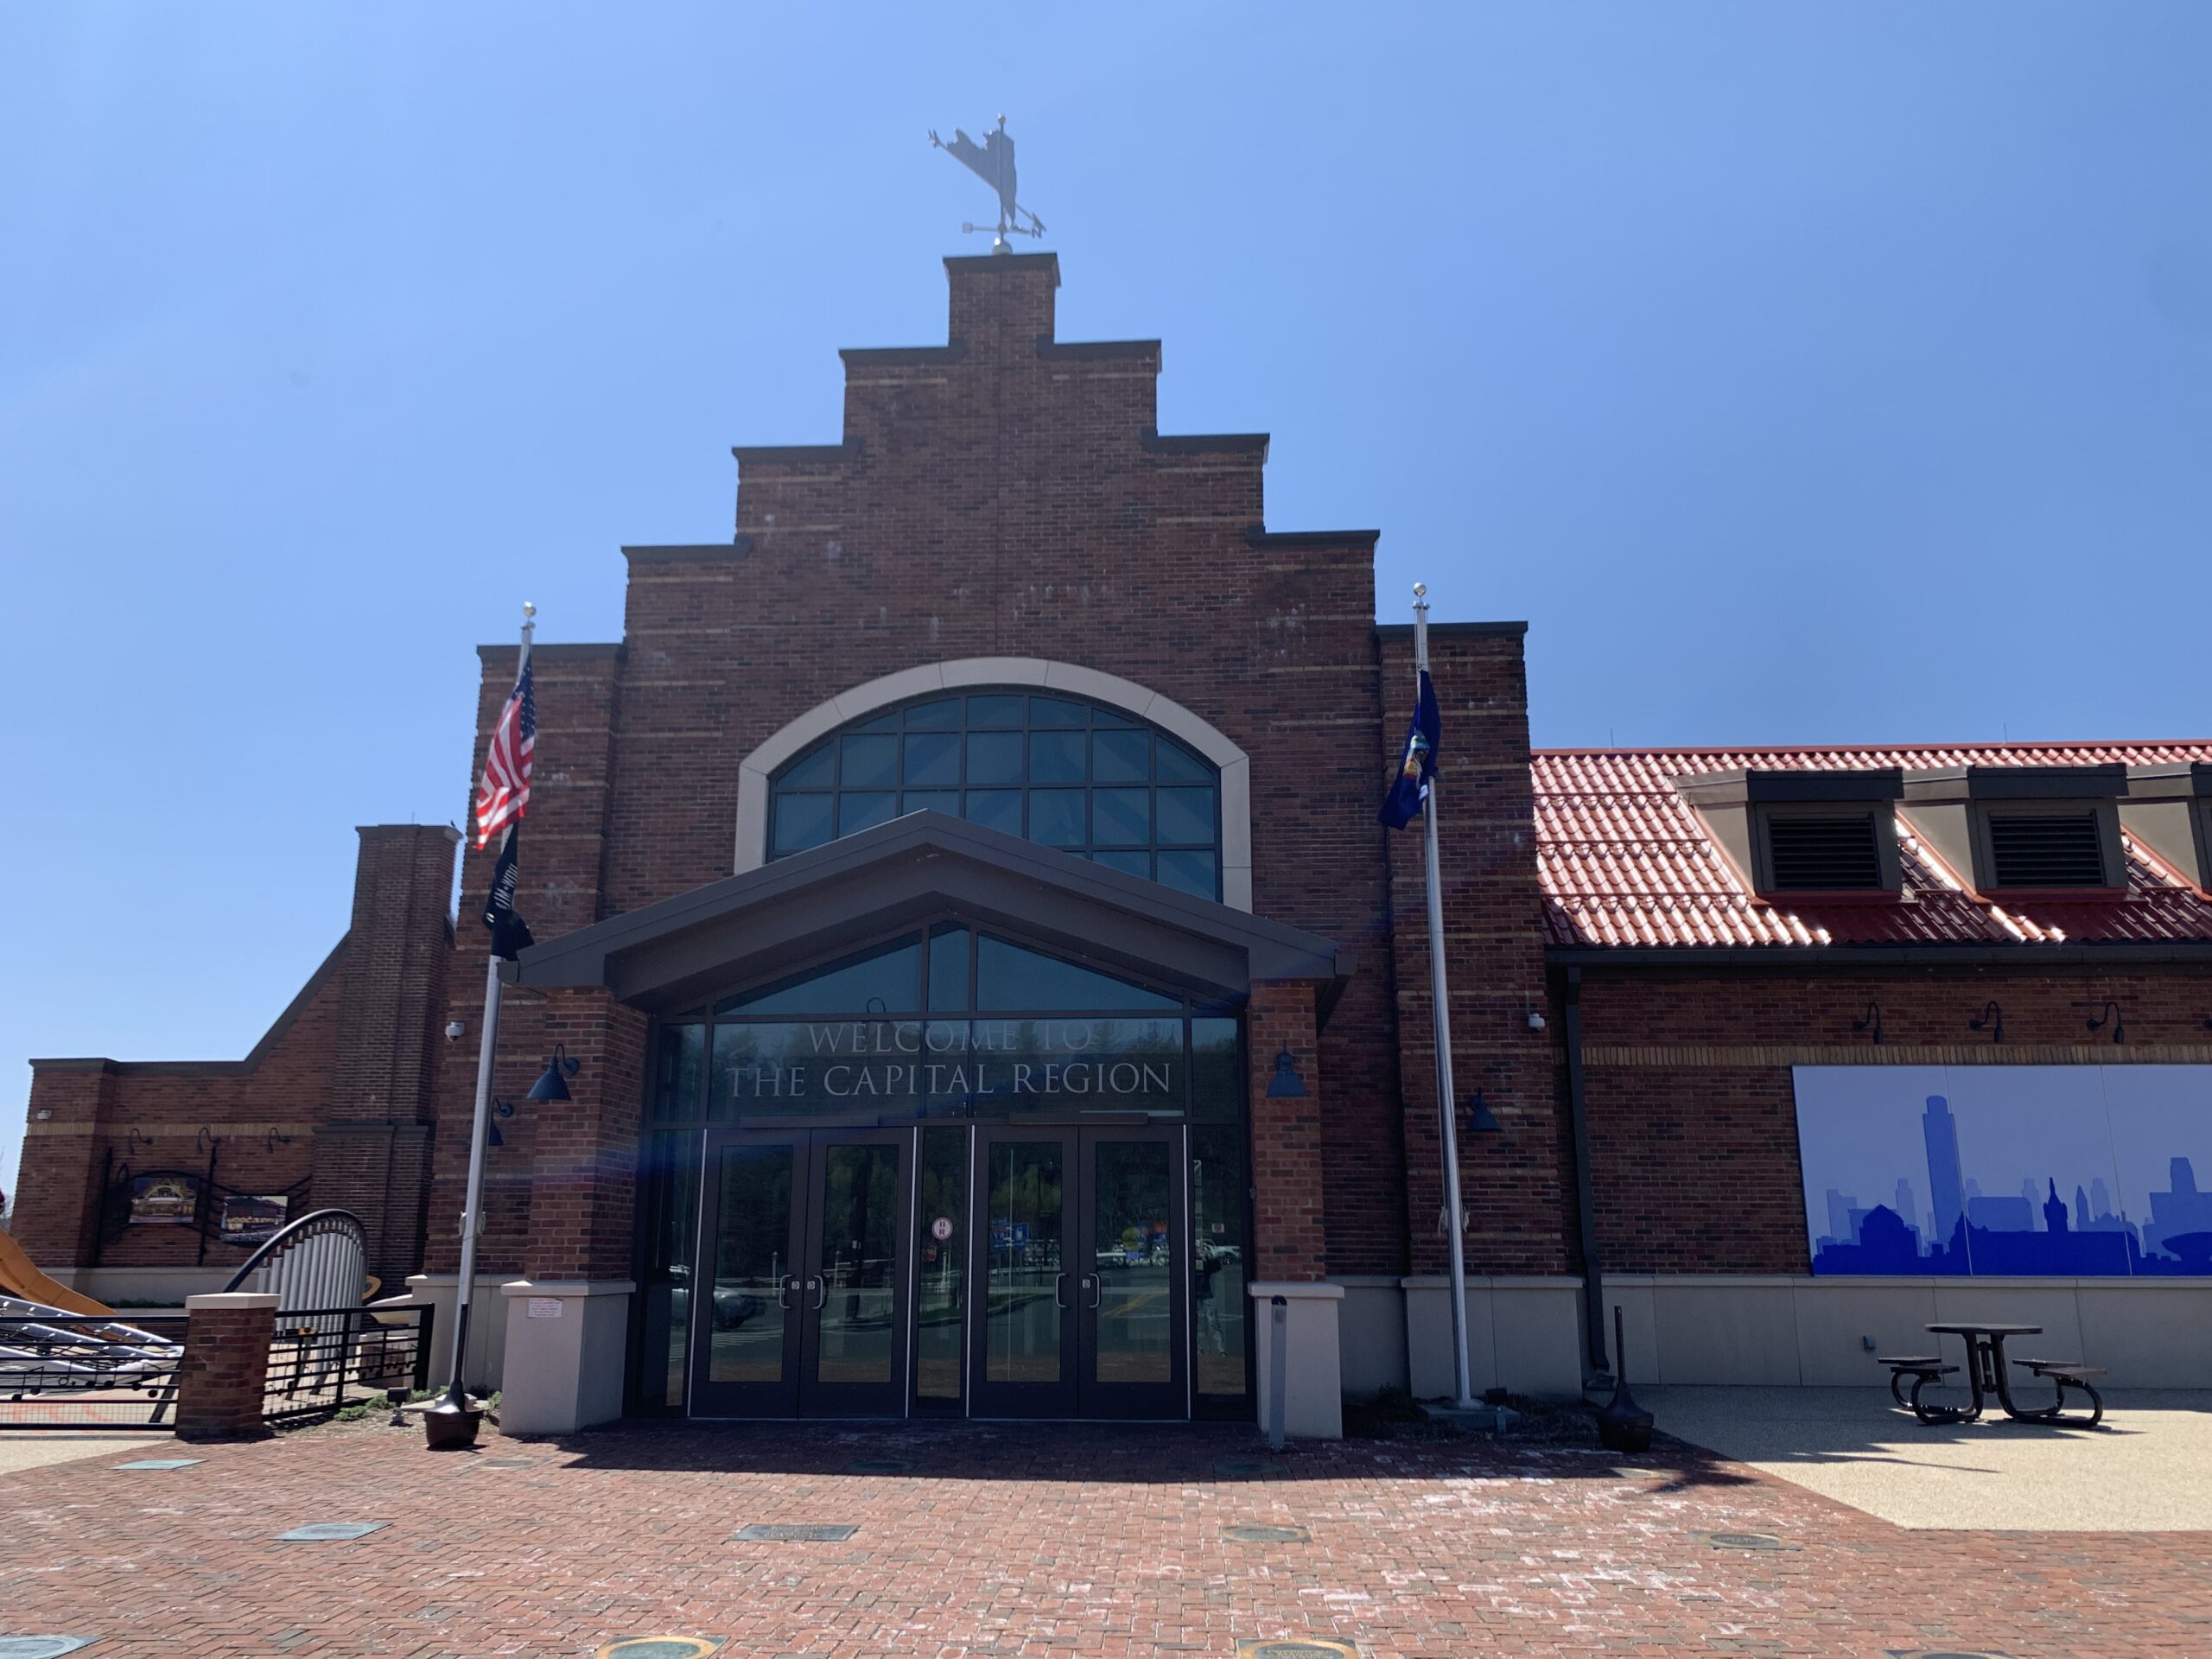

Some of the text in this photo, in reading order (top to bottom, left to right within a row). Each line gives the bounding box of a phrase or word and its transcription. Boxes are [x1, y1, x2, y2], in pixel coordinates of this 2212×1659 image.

[807, 1021, 1092, 1053] WELCOME TO
[725, 1062, 1170, 1097] THE CAPITAL REGION
